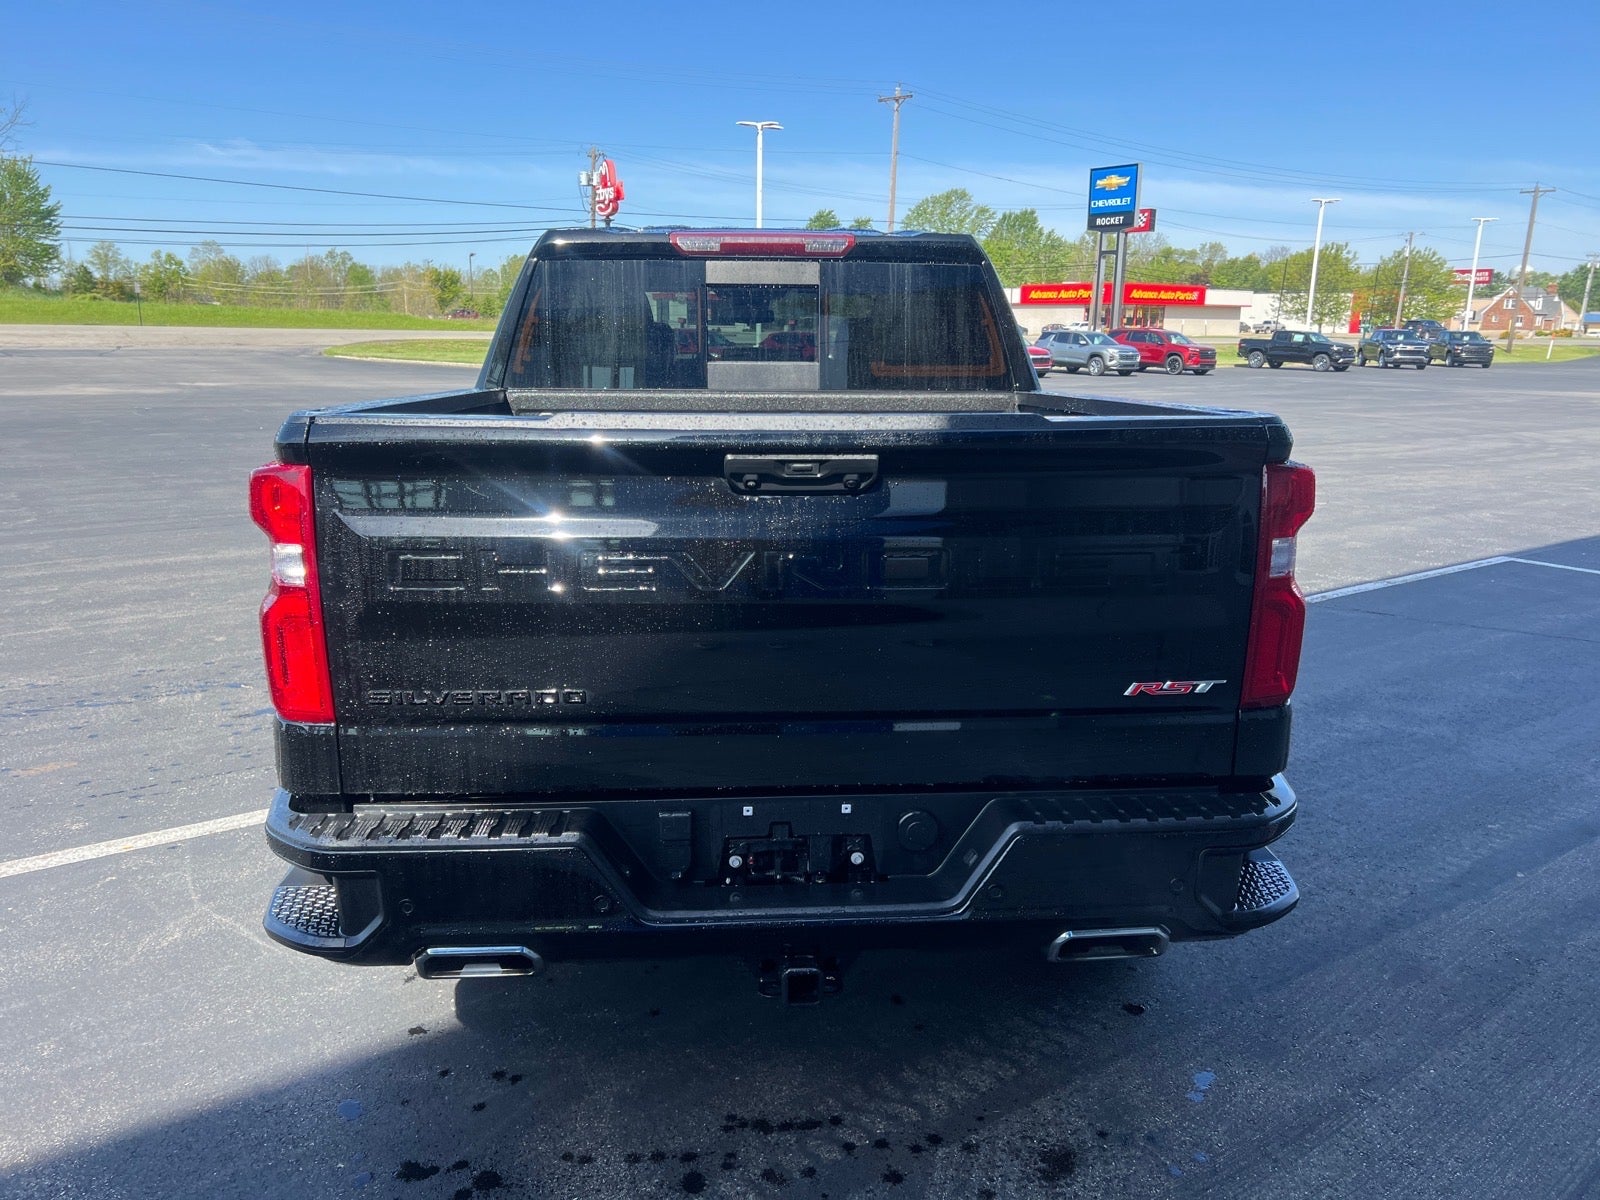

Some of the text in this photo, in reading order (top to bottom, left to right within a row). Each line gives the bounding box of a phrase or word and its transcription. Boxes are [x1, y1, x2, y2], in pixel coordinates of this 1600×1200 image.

[1091, 197, 1132, 208] CHEVROLET
[1096, 216, 1124, 226] ROCKET
[1029, 290, 1058, 299] Advance
[1058, 289, 1077, 299] Auto
[1130, 289, 1158, 299] Advance
[1158, 290, 1176, 300] Auto
[1123, 680, 1227, 696] RST
[367, 689, 587, 705] SILVERADO
